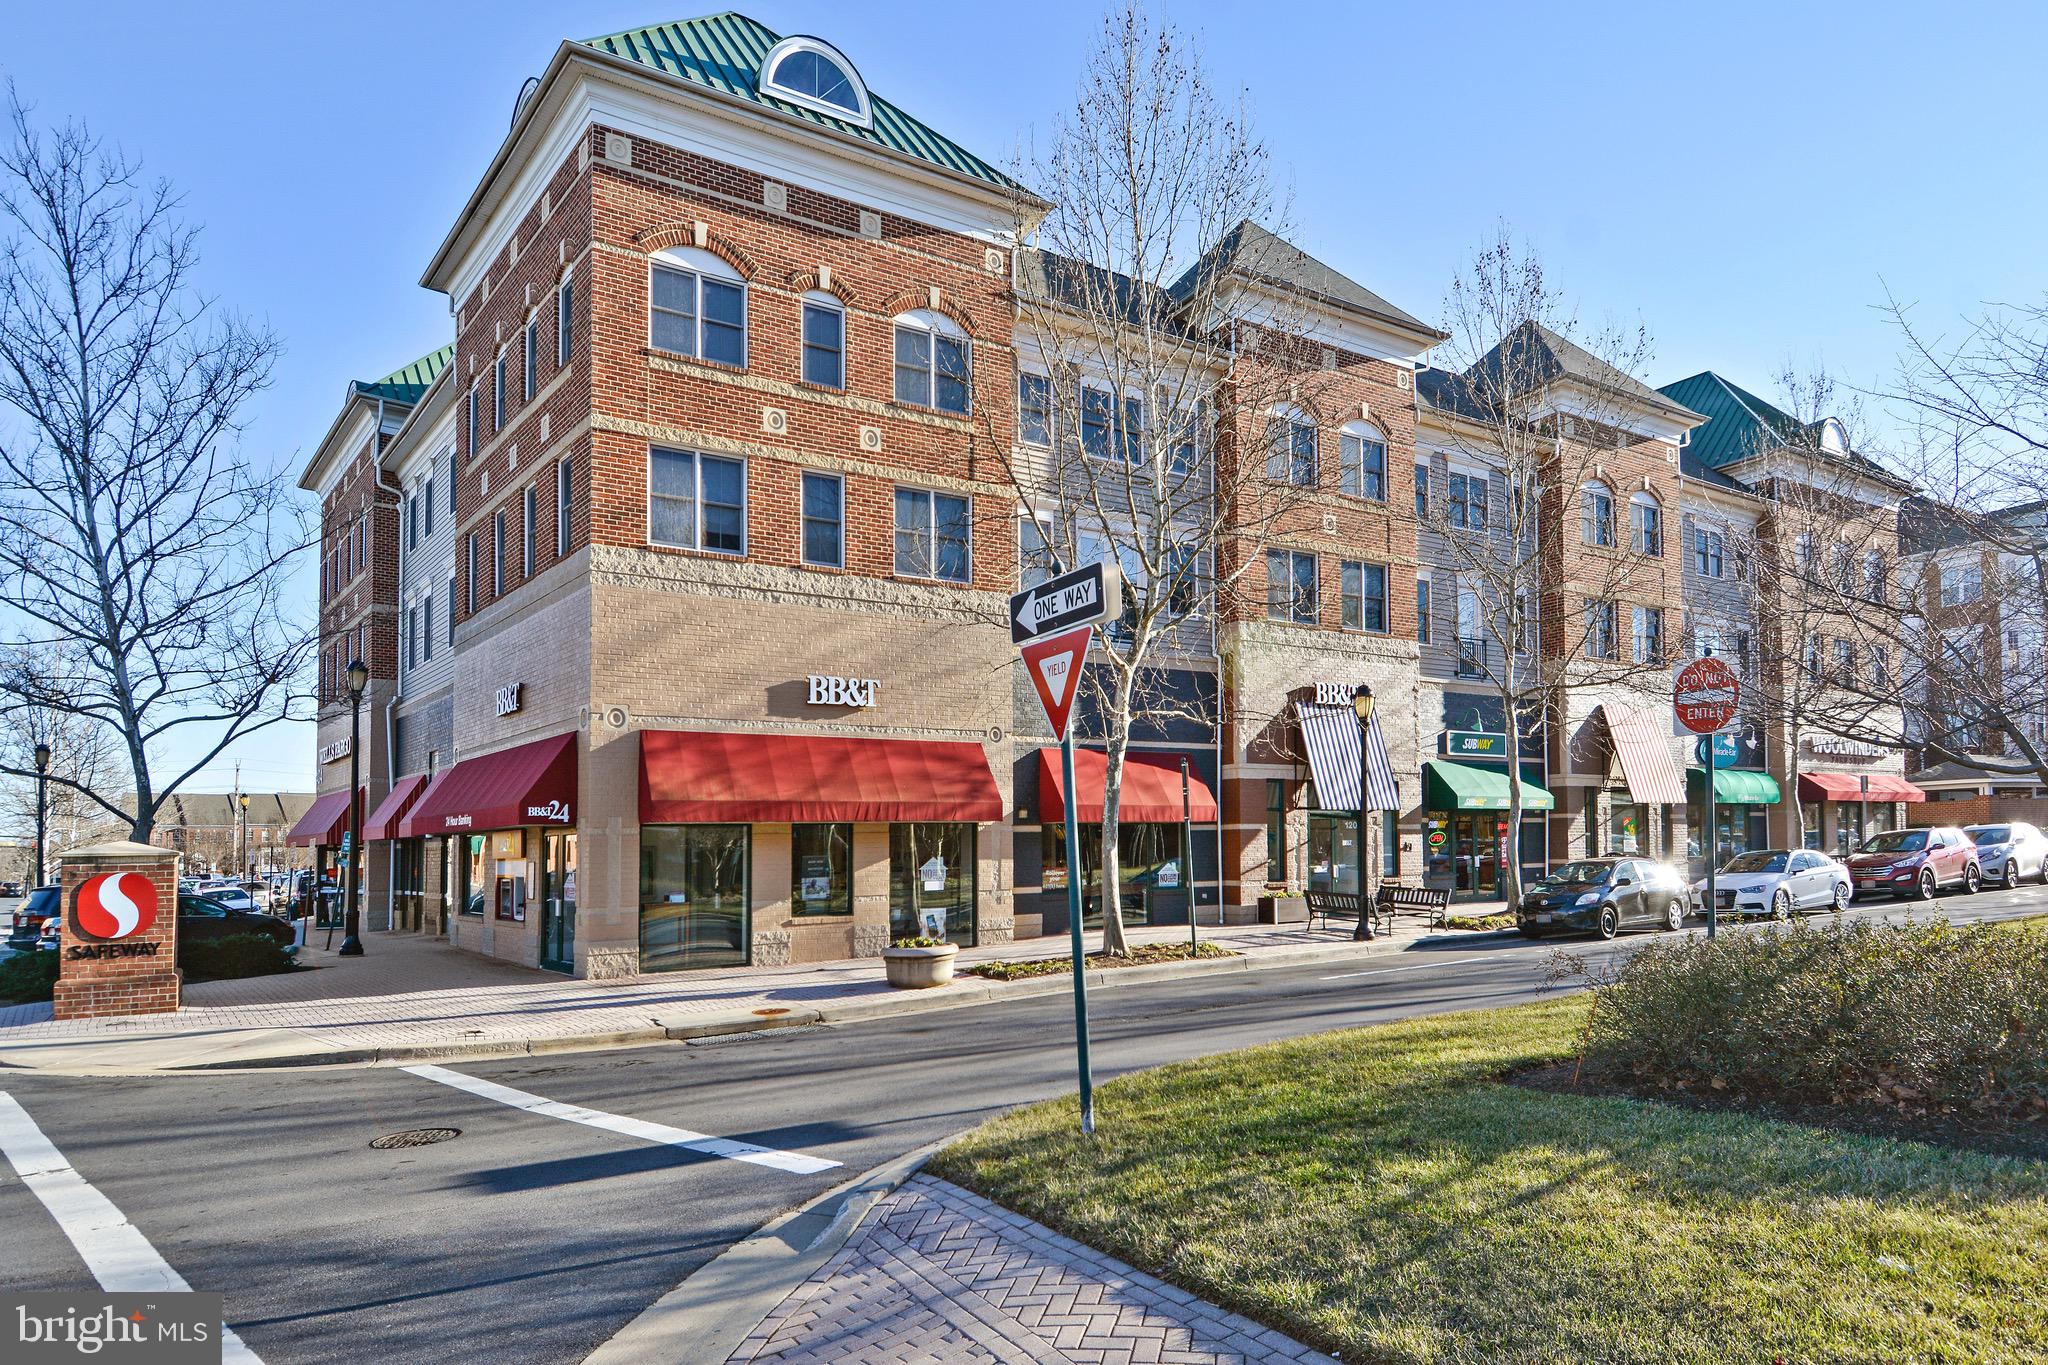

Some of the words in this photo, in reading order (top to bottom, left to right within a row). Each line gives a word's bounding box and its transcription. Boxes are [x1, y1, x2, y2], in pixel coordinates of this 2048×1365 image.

[1034, 595, 1058, 620] ONE
[1064, 581, 1091, 609] WAY
[1047, 661, 1066, 677] YIELD
[1682, 673, 1698, 687] DO
[807, 675, 881, 707] BB&T
[496, 682, 520, 717] BB&T
[1687, 706, 1724, 720] ENTER
[1462, 738, 1494, 750] SUBWAY
[1430, 834, 1444, 842] OPEN
[66, 942, 161, 960] SAFEWAY
